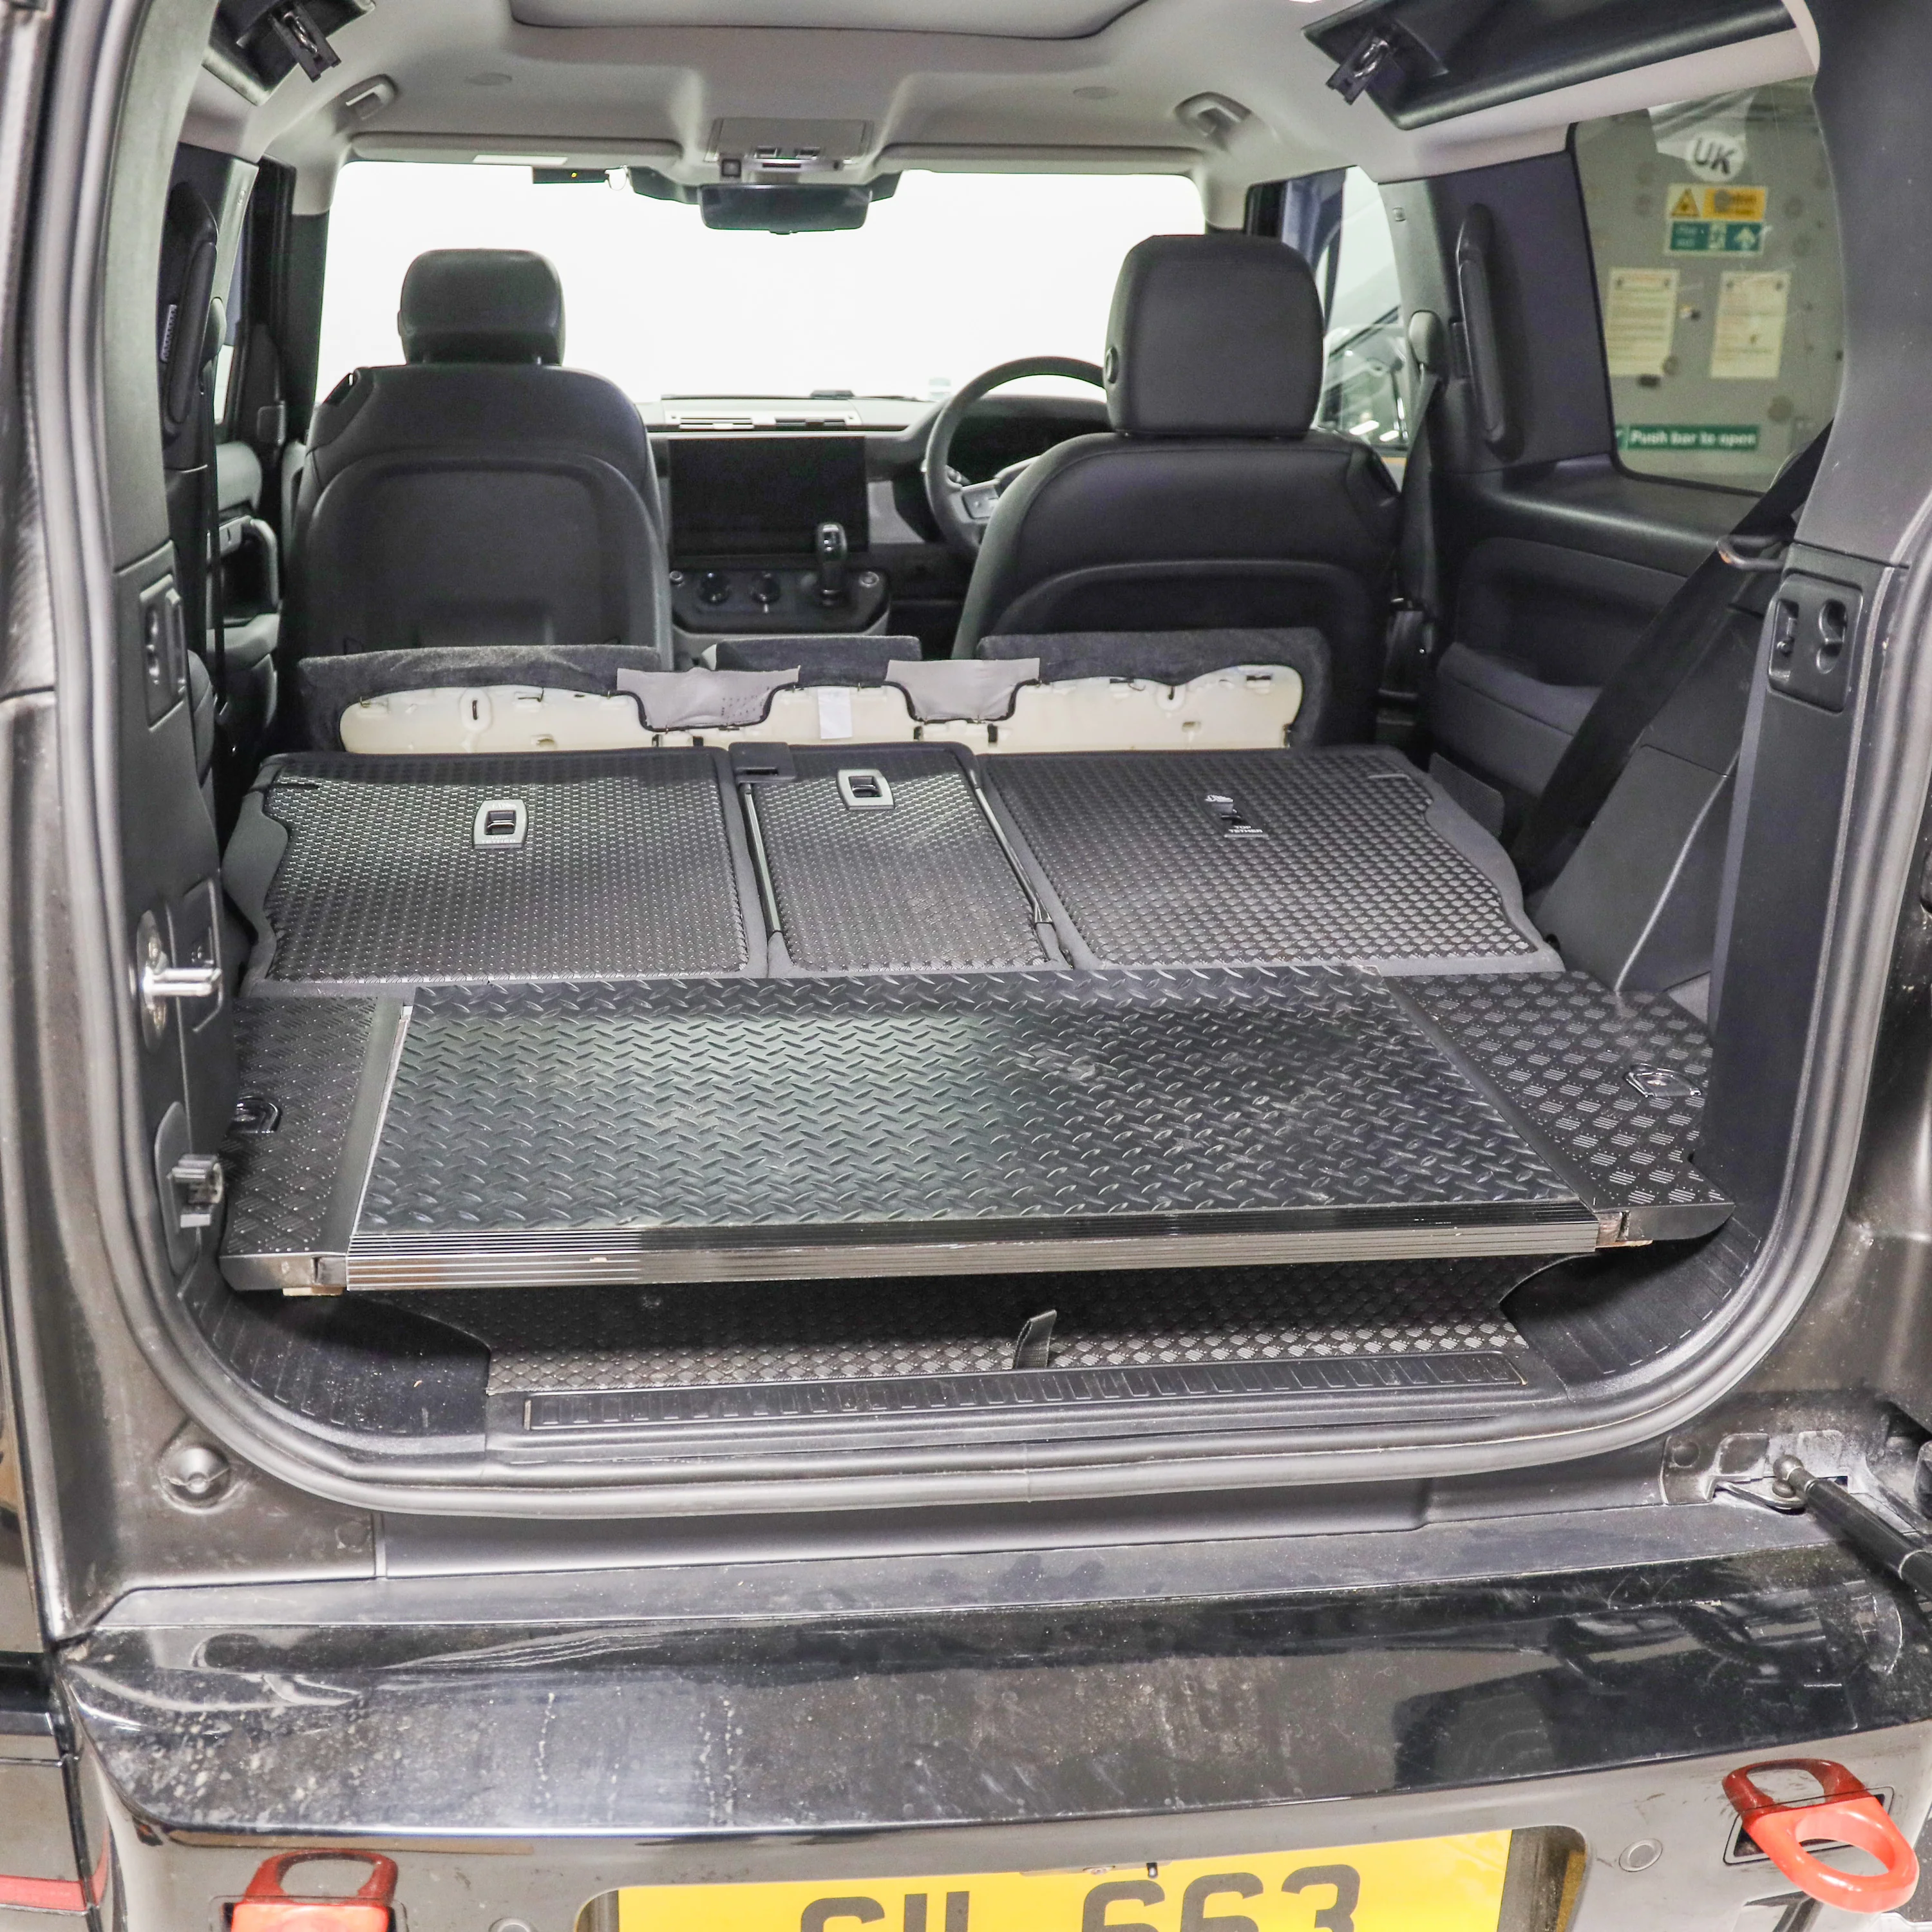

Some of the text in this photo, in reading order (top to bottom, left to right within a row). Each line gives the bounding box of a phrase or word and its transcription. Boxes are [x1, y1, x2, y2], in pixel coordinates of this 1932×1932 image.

[1694, 137, 1735, 175] UK
[1631, 430, 1757, 447] Push bar to open
